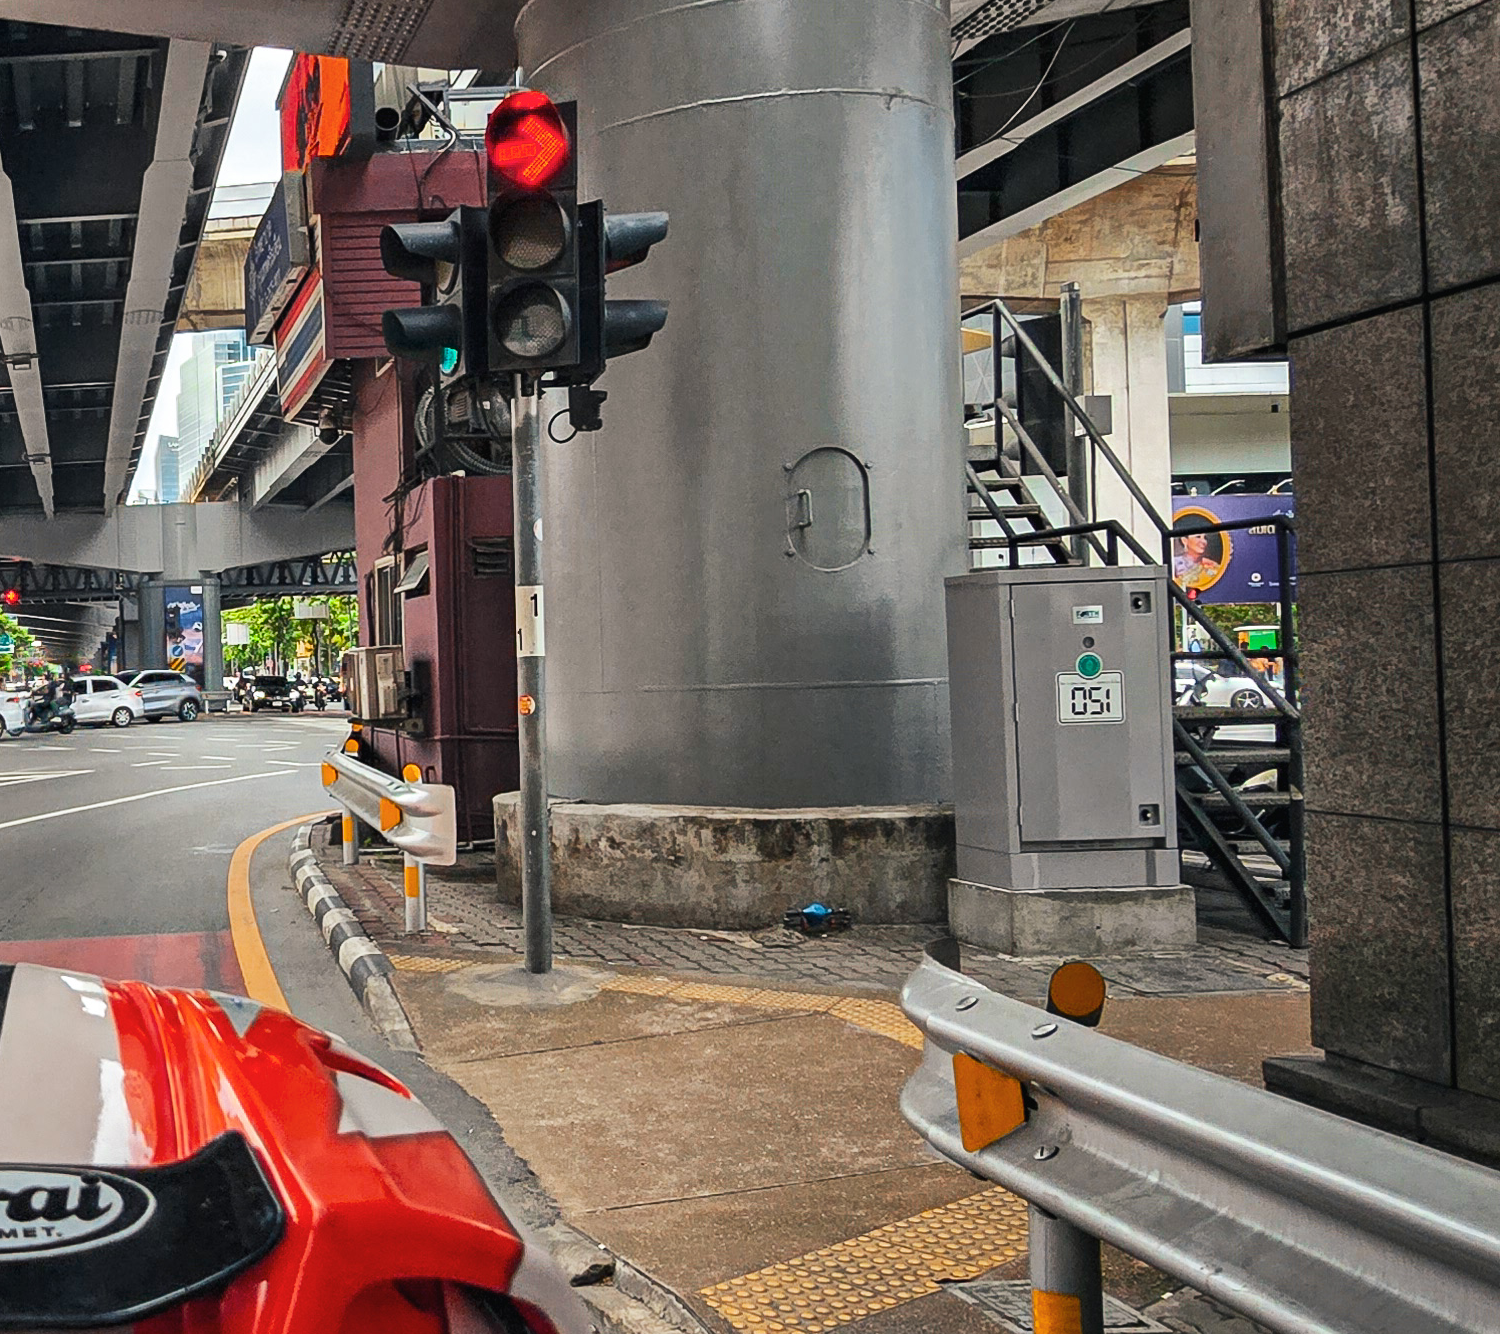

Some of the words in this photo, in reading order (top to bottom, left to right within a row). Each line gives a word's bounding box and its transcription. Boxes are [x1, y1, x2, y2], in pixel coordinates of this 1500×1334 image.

[529, 593, 538, 617] 1
[517, 628, 523, 651] 1
[1071, 686, 1111, 715] 051
